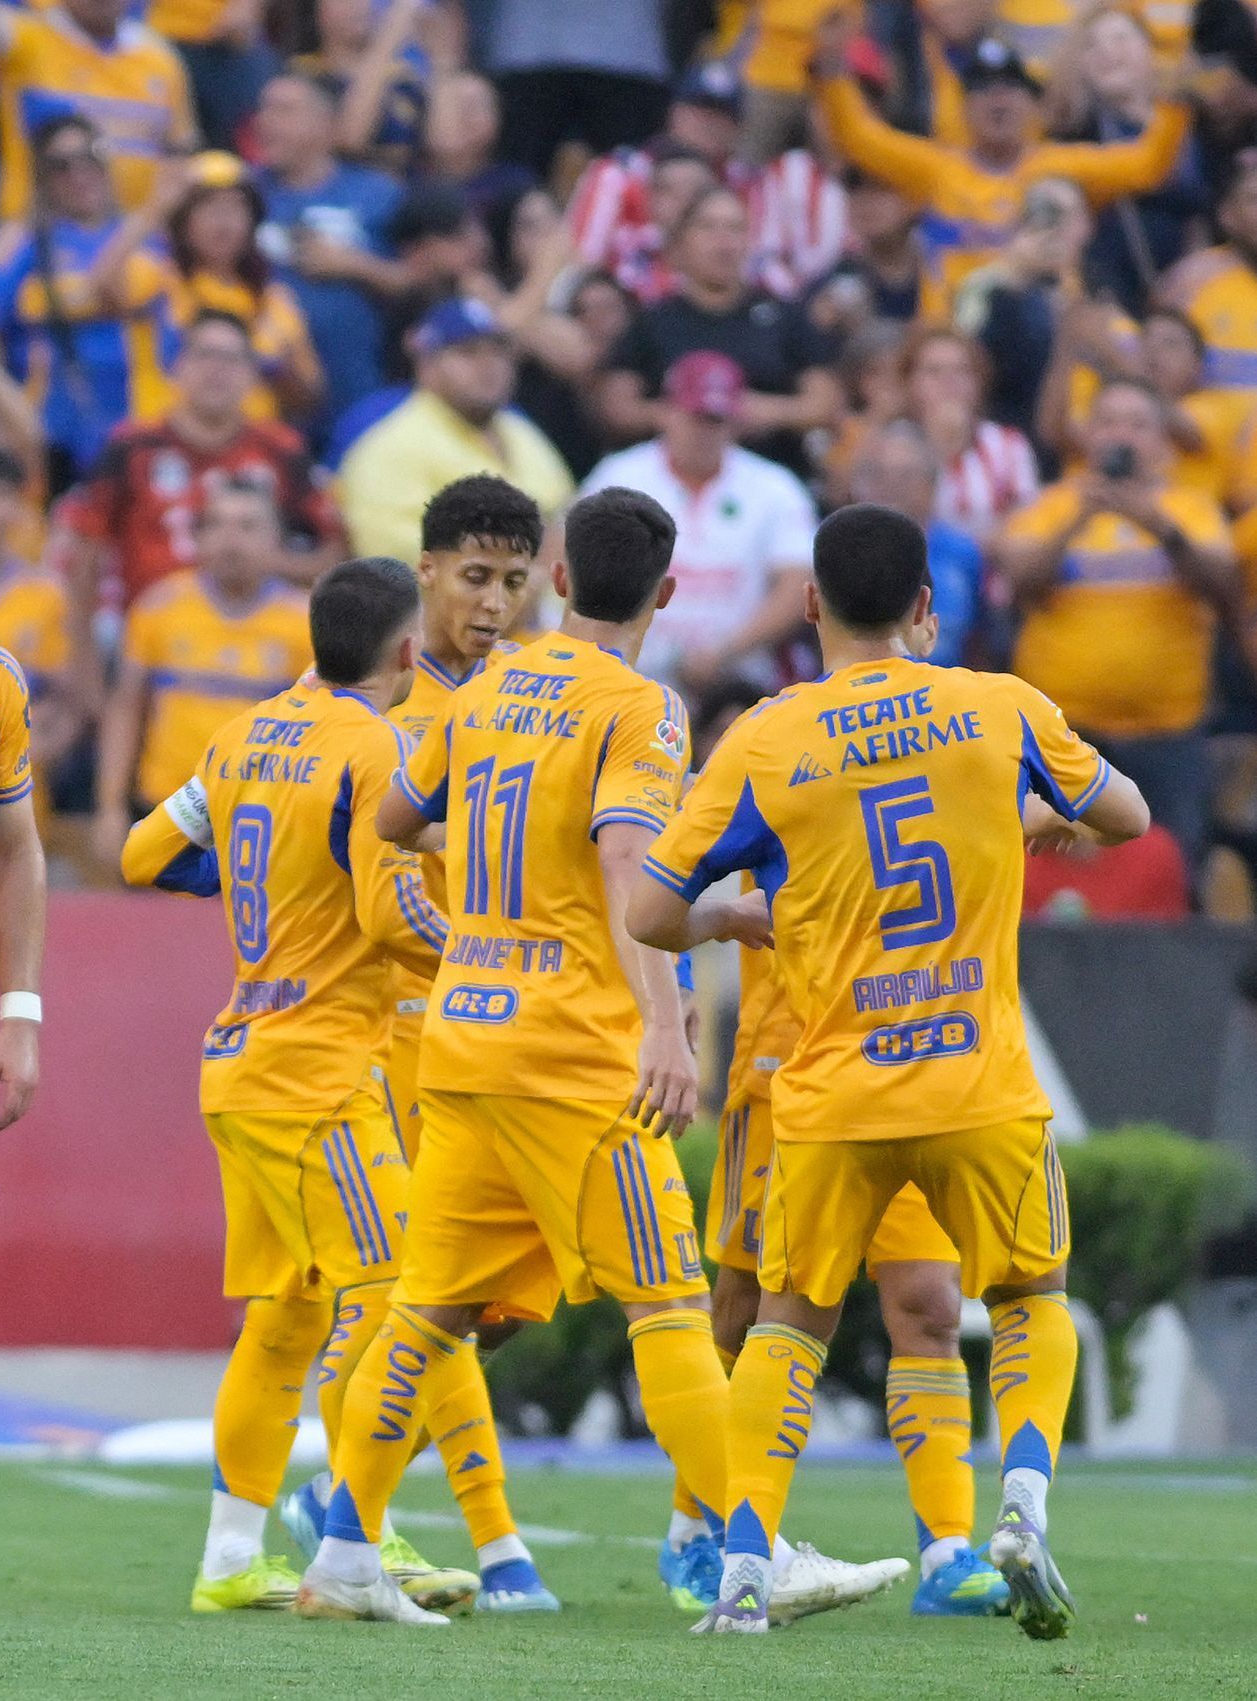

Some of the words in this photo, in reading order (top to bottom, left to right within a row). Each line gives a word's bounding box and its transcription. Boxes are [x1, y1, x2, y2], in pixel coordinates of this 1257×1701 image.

[486, 703, 584, 738] AFIRME
[817, 684, 934, 739] TECATE
[841, 710, 984, 773] AFIRME
[230, 803, 273, 964] 8
[463, 755, 535, 919] 11
[858, 775, 957, 952] 5
